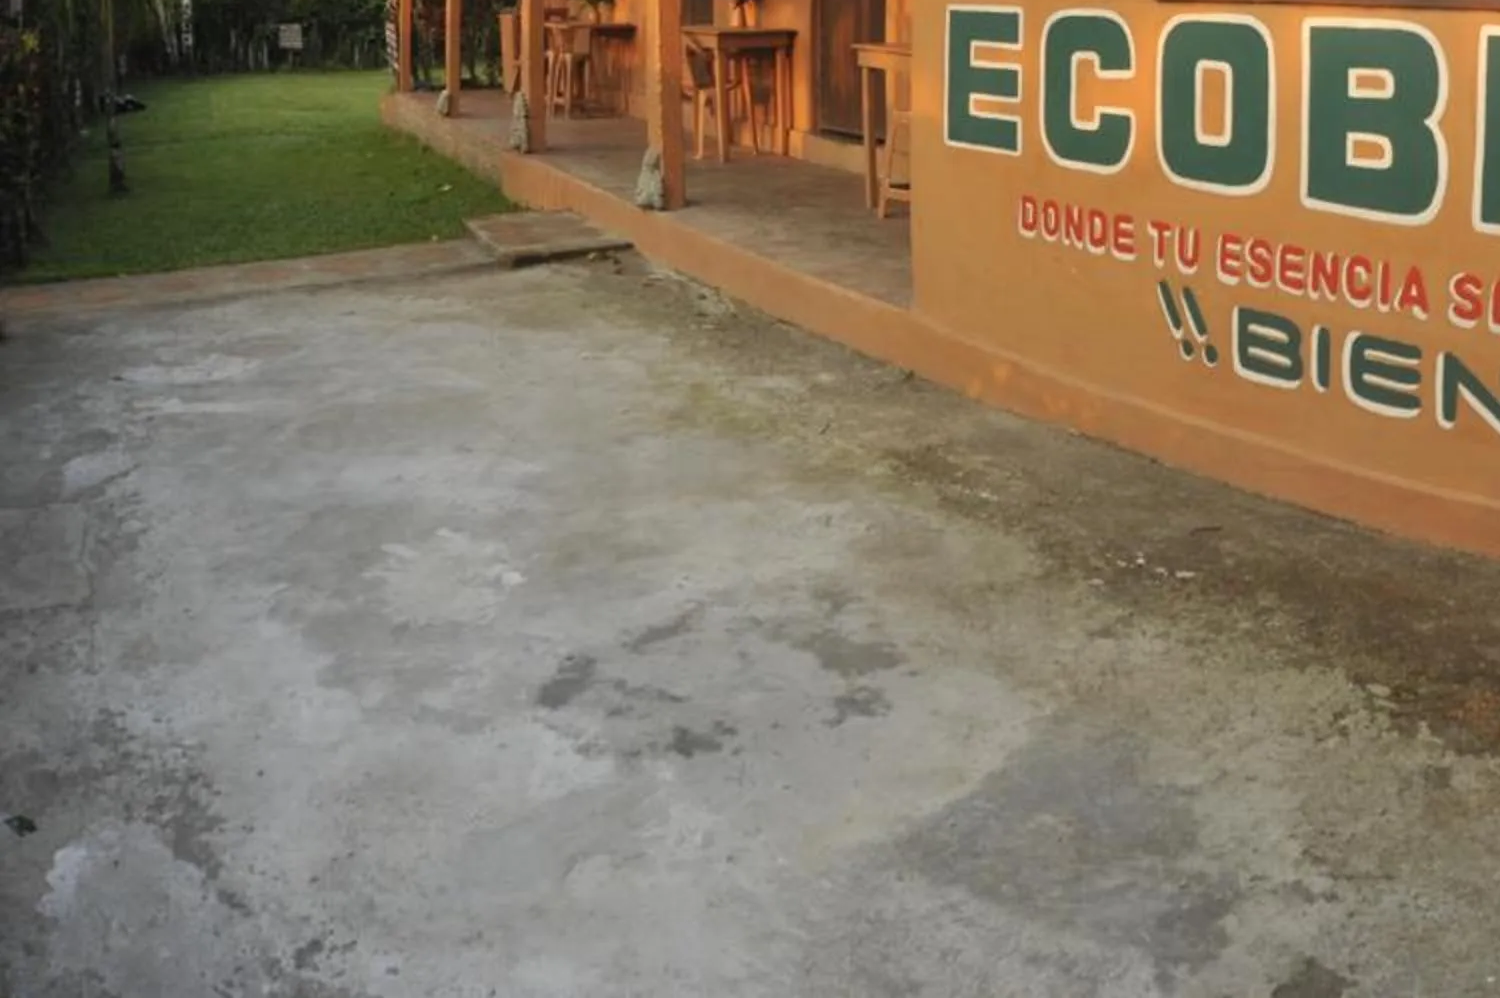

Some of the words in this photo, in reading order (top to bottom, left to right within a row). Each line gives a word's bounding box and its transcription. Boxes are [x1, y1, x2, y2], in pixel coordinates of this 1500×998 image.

[1018, 195, 1137, 262] DONDE
[1148, 219, 1202, 274] TU
[1215, 233, 1431, 318] ESENCIA
